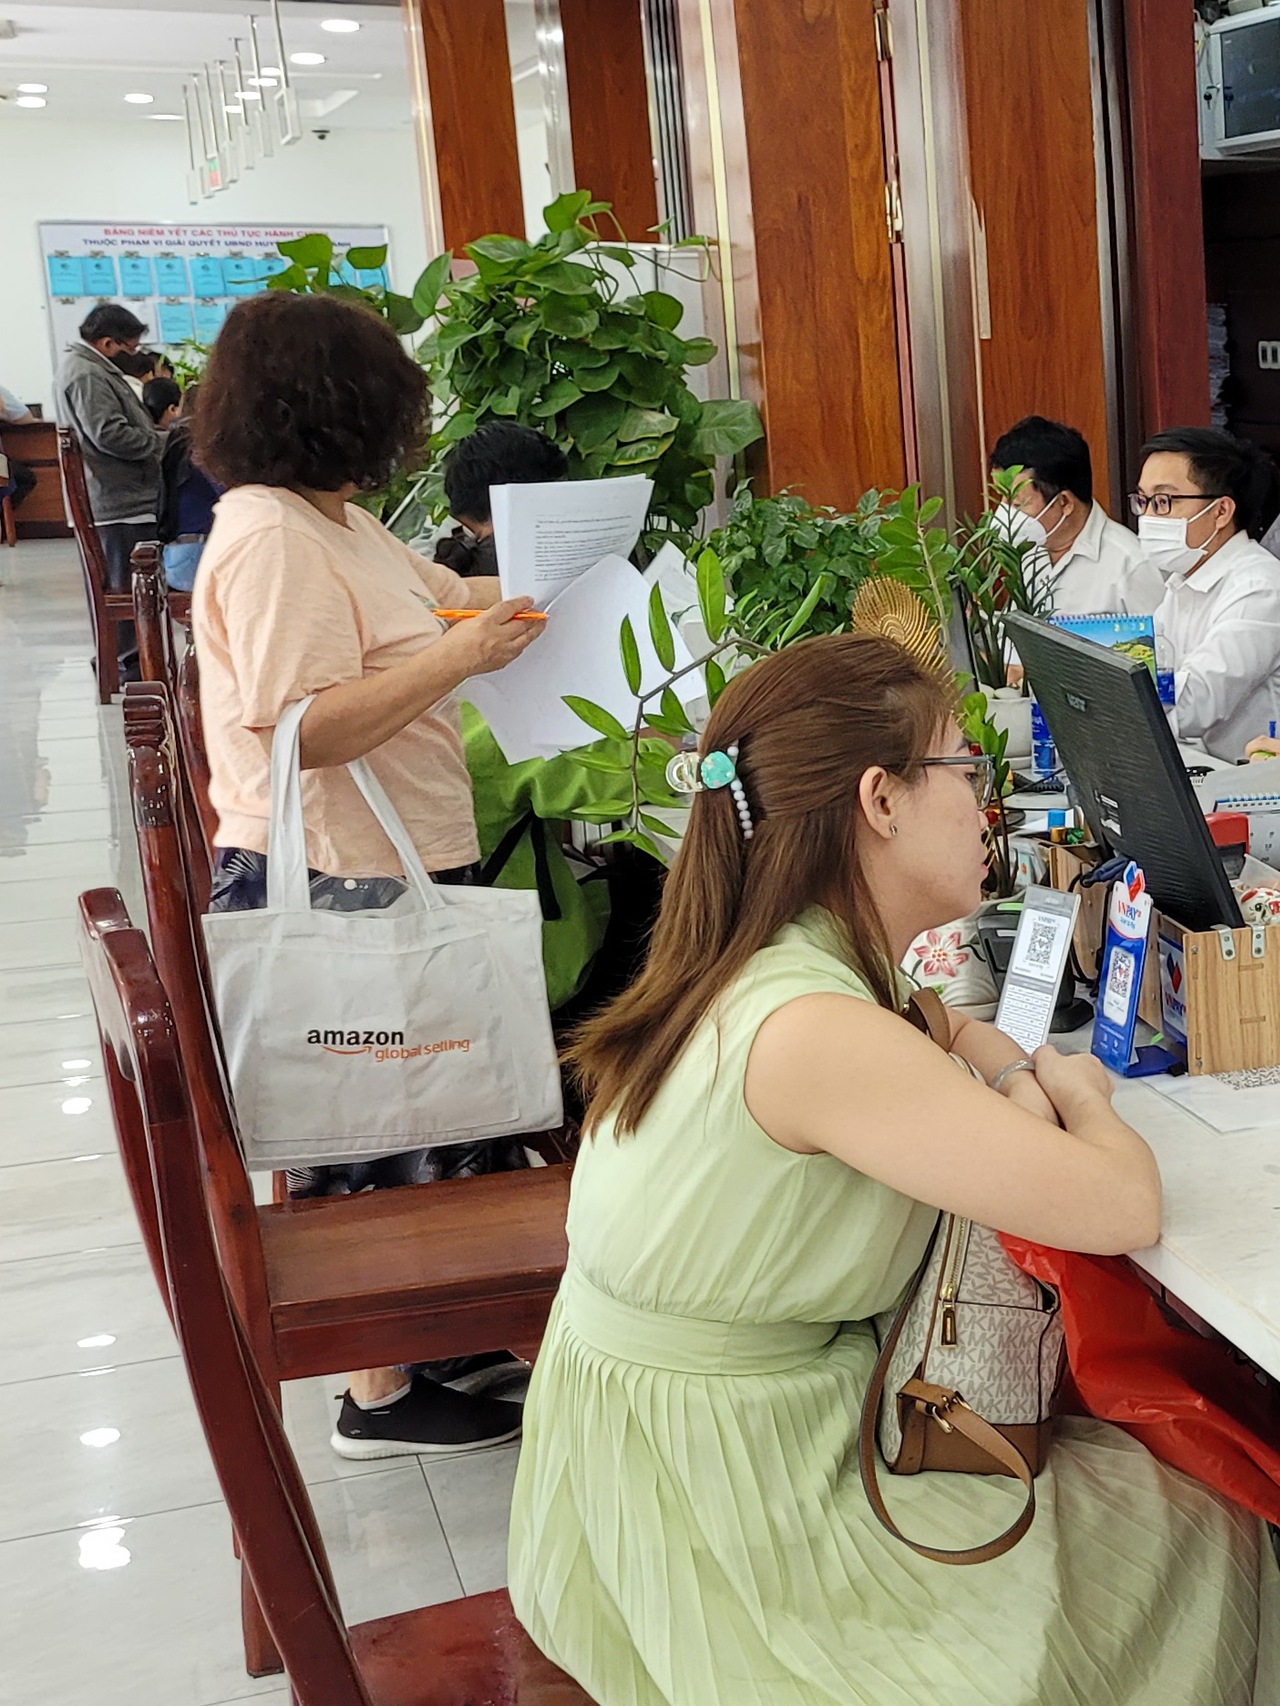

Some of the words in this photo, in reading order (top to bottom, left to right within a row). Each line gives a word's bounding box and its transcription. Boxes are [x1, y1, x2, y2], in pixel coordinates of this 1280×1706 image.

[307, 1028, 404, 1045] amazon
[375, 1044, 422, 1062] global
[423, 1039, 470, 1054] selling
